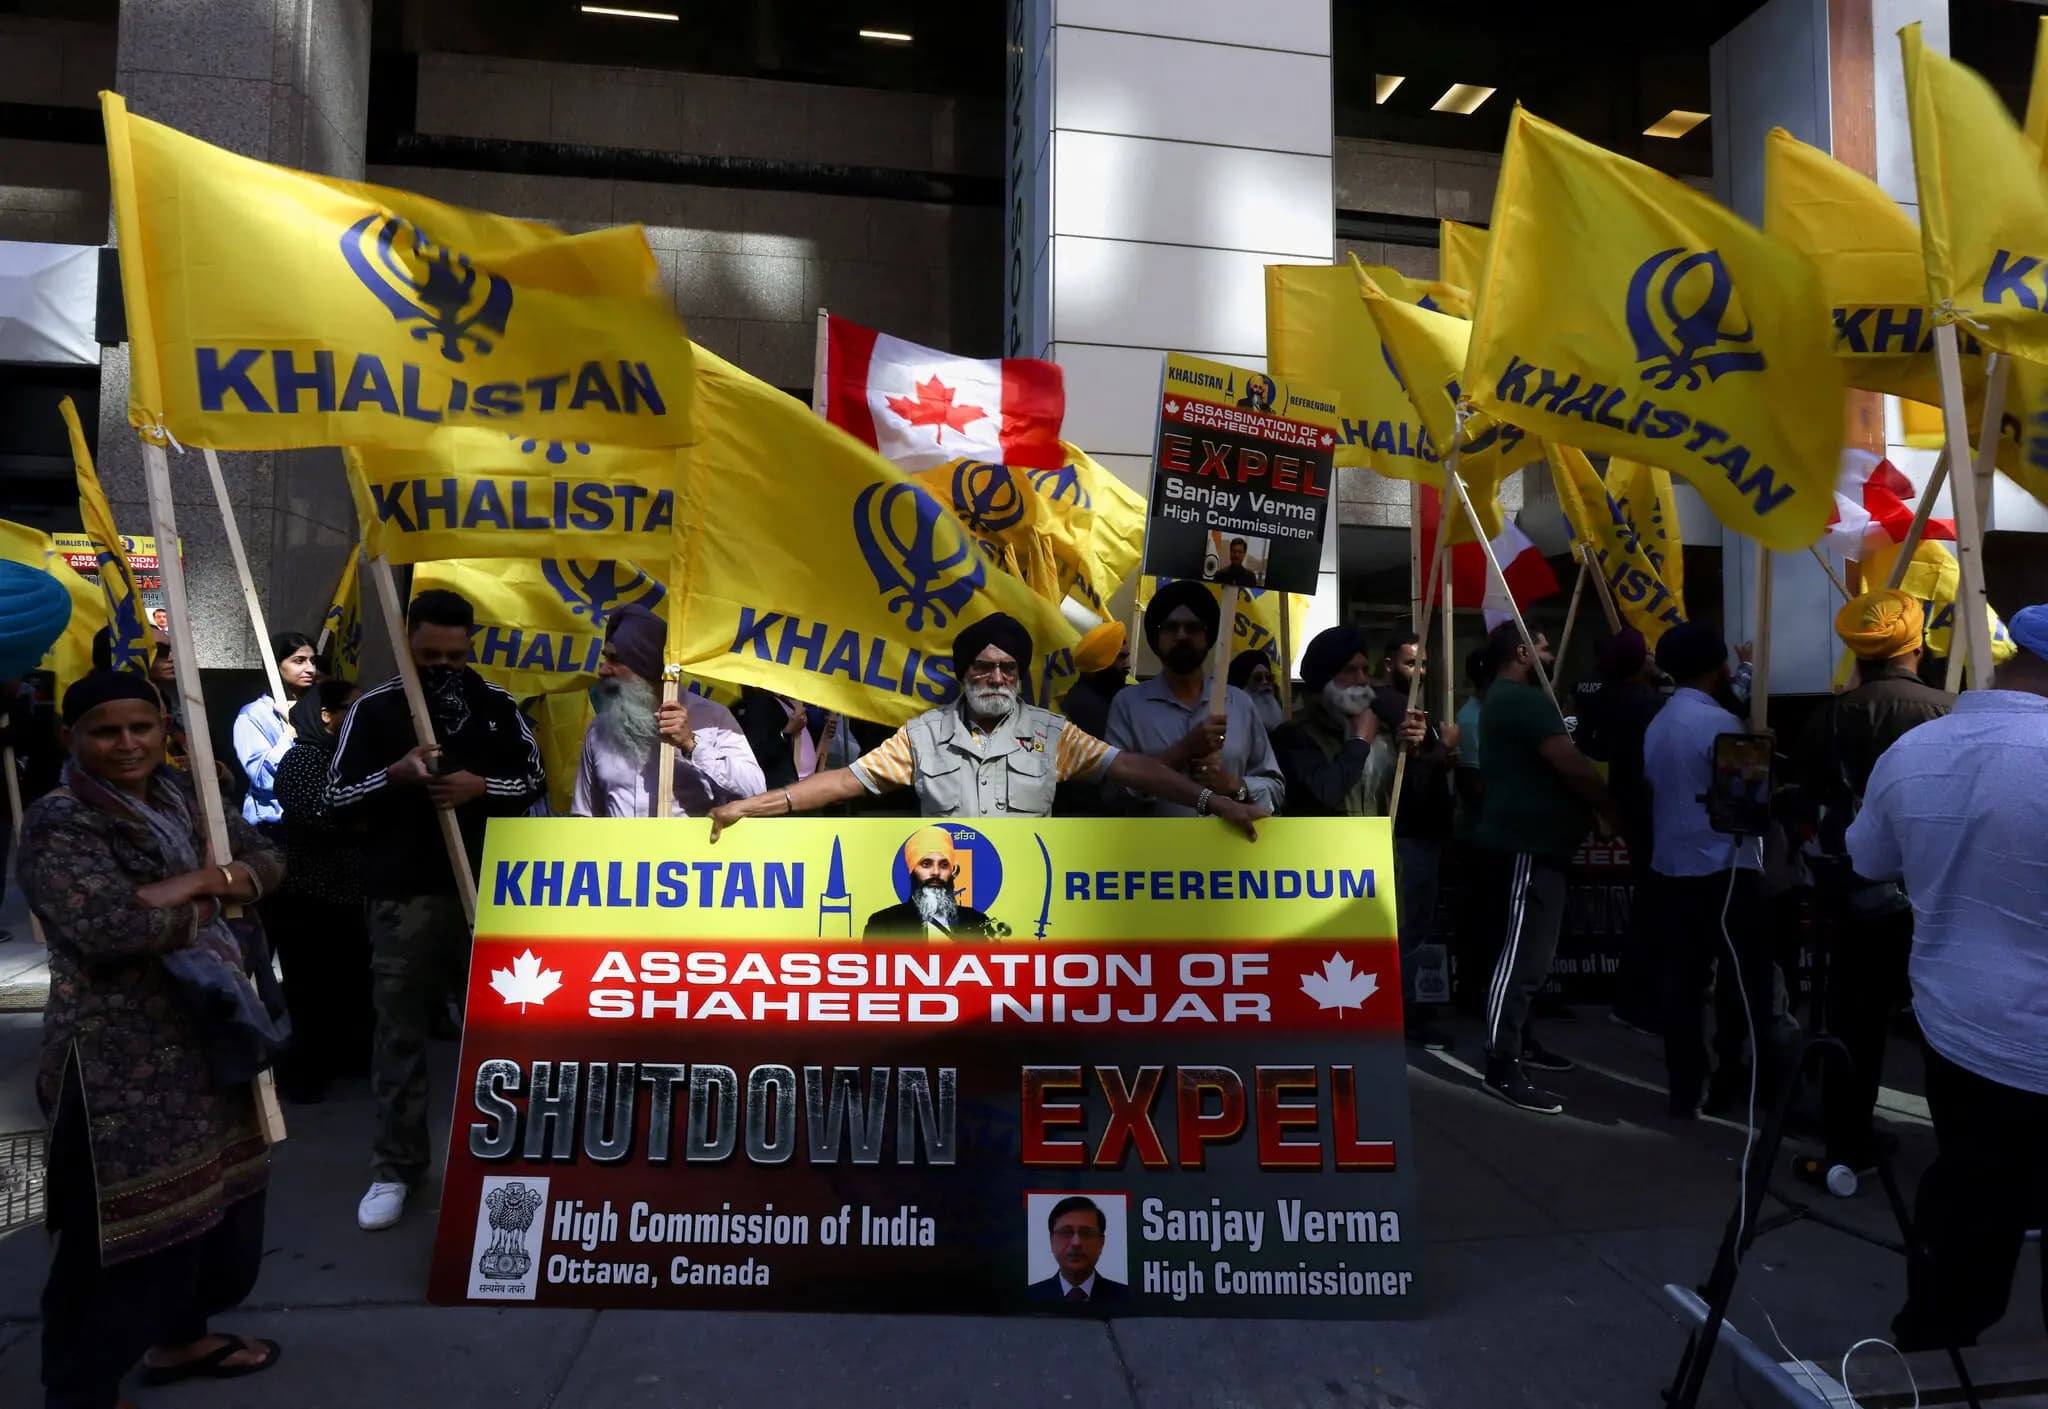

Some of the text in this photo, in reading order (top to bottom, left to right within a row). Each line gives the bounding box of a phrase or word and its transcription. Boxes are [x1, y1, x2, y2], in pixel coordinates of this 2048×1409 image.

[195, 347, 667, 424] KHALISTAN
[1168, 366, 1336, 414] KHALISTAN REFERENDUM
[1183, 412, 1317, 448] SHAHEED NIJJAR
[1184, 401, 1318, 437] ASSASSINATION OF
[1496, 355, 1795, 517] KHALISTAN
[1161, 432, 1327, 497] EXPEL
[371, 478, 674, 536] KHALISTA
[1163, 503, 1314, 540] High Commissioner
[1166, 477, 1316, 521] Sanjay Verma
[55, 539, 92, 548] KHALISTA
[730, 607, 965, 706] KHALIS
[492, 861, 1376, 909] KHALISTAN REFERENDUM
[590, 951, 1270, 987] ASSASSINATION OF
[588, 990, 1272, 1023] SHAHEED NIJJAR
[468, 1059, 1397, 1170] SHUTDOWN EXPEL
[550, 1199, 936, 1252] High Commission of India
[1141, 1197, 1401, 1252] Sanjay Verma
[547, 1253, 771, 1289] Ottawa, Canada
[1143, 1260, 1414, 1302] High Commissioner
